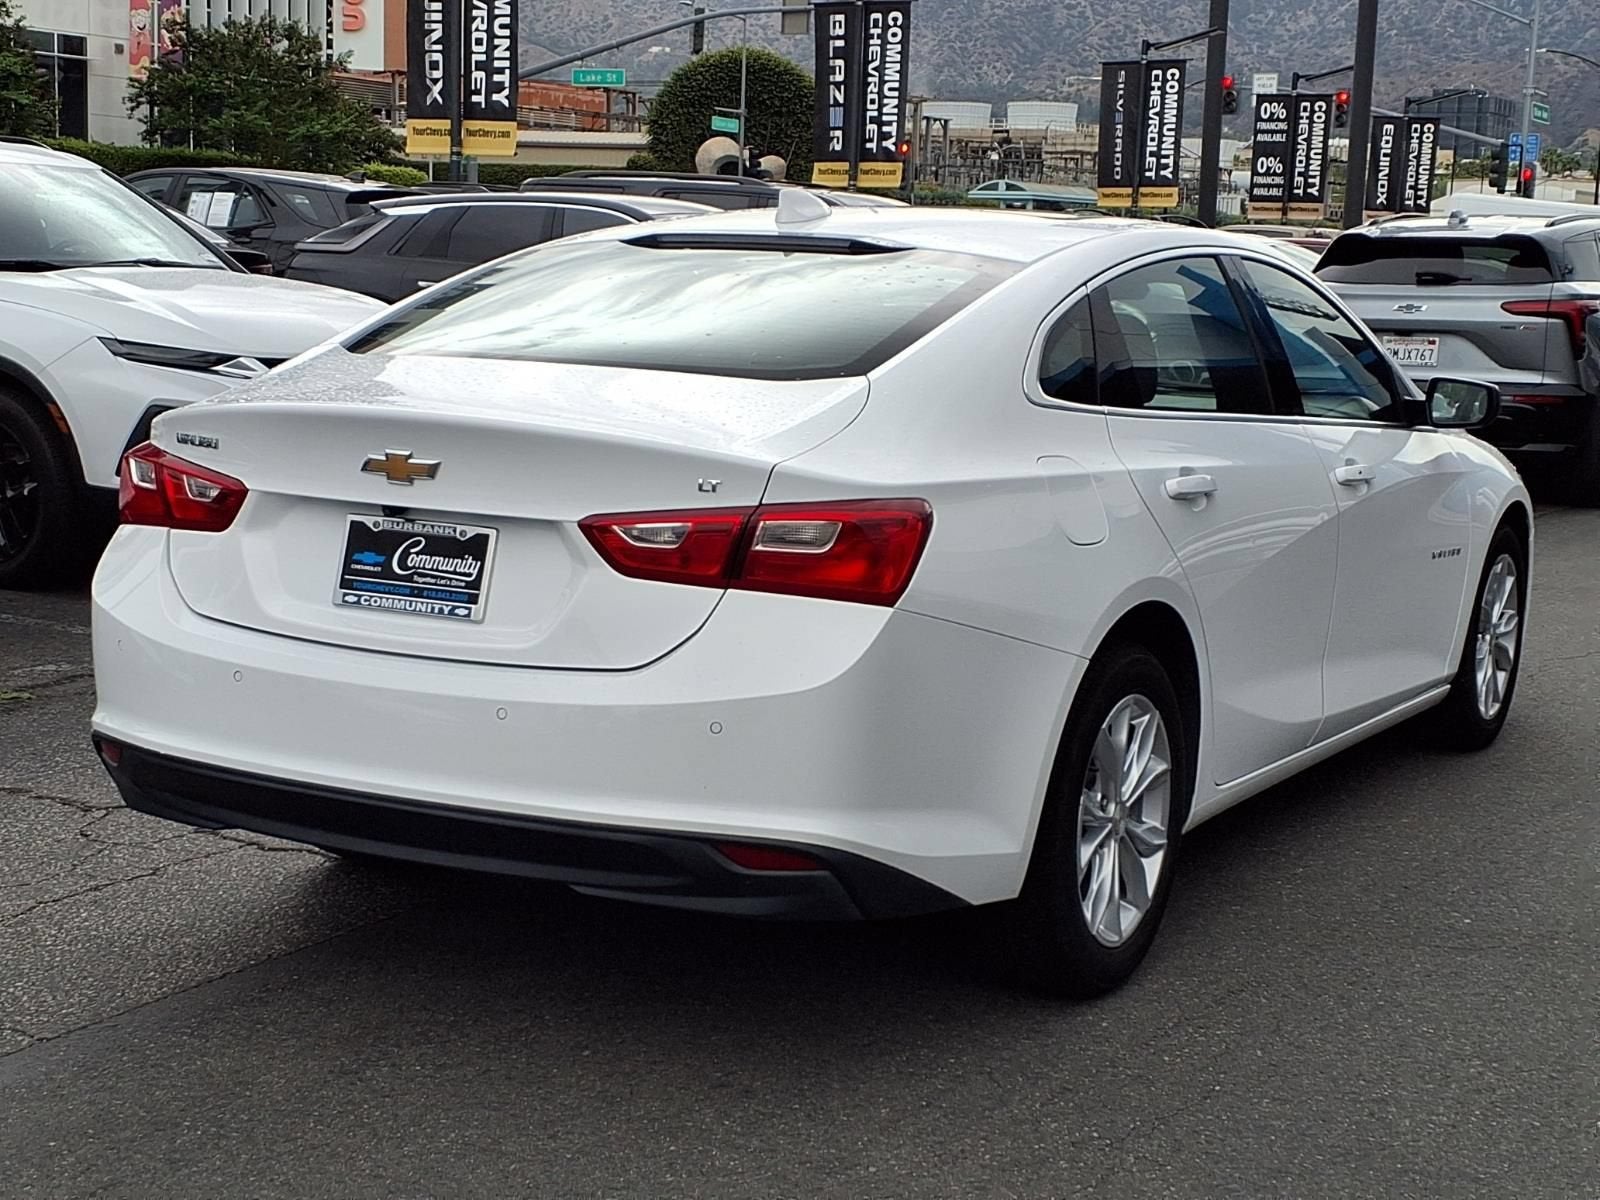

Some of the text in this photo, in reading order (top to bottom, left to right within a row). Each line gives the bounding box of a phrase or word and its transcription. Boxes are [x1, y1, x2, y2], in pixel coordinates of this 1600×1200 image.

[580, 72, 617, 82] Lake St
[829, 14, 846, 152] BLAZER
[865, 12, 882, 153] CHEVROLET
[881, 10, 903, 152] COMMUNITY
[1113, 69, 1126, 180] SILVERADO
[1144, 69, 1163, 180] CHEVROLET
[1159, 67, 1181, 180] COMMUNITY
[1256, 121, 1288, 130] FINANCING
[1260, 102, 1287, 120] 0%
[412, 126, 452, 137] YourChevy.co
[465, 127, 511, 139] YourChevy.com
[1256, 133, 1287, 142] AVAILABLE
[1257, 156, 1283, 174] 0%
[1293, 101, 1311, 197] CHEVROLET
[1306, 101, 1327, 197] COMMUNITY
[1376, 124, 1395, 206] EQUINOX
[1253, 176, 1285, 185] FINANCING
[1404, 124, 1421, 208] CHEVROLET
[1416, 123, 1435, 208] COMMUNITY
[1253, 187, 1283, 196] AVAILABLE
[698, 478, 722, 493] LT
[382, 520, 457, 536] BURBANK
[392, 536, 481, 581] Community
[360, 595, 453, 615] COMMUNITY
